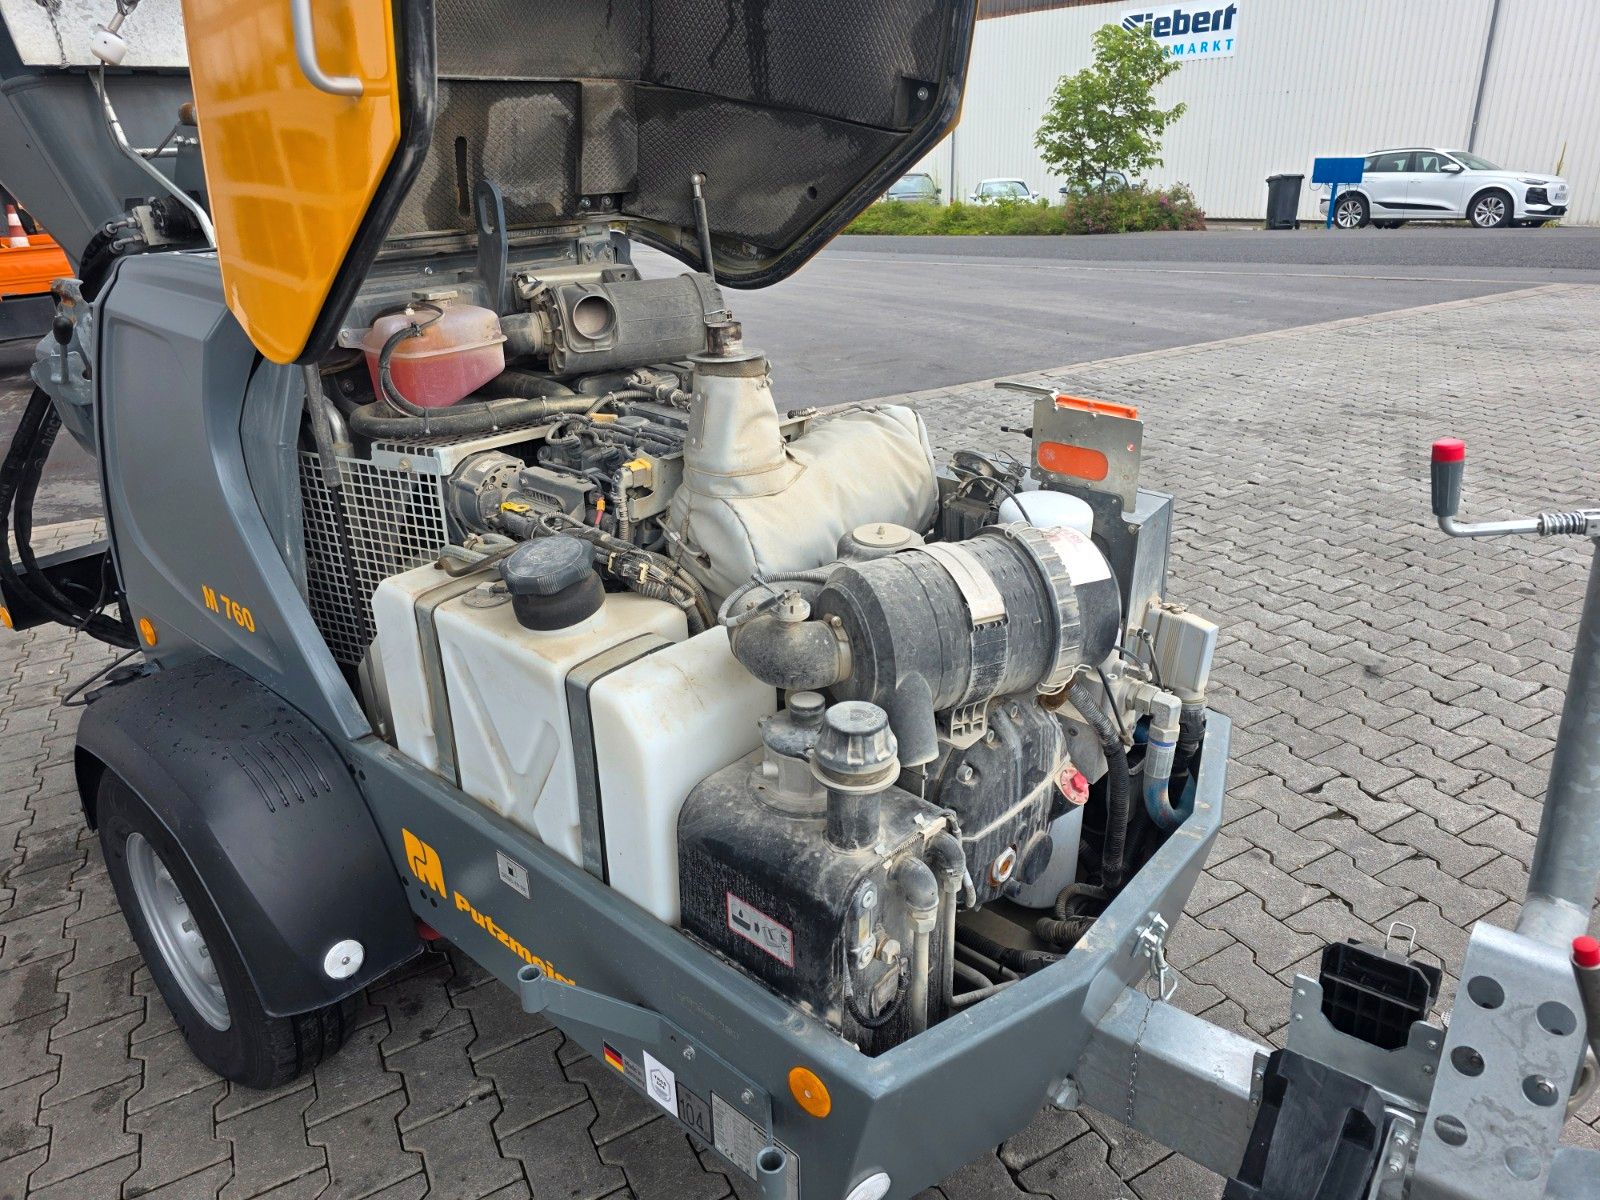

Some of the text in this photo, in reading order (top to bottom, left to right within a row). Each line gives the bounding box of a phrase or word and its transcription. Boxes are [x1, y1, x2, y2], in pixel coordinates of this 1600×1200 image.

[201, 584, 256, 633] M 760
[680, 1098, 704, 1131] 104
